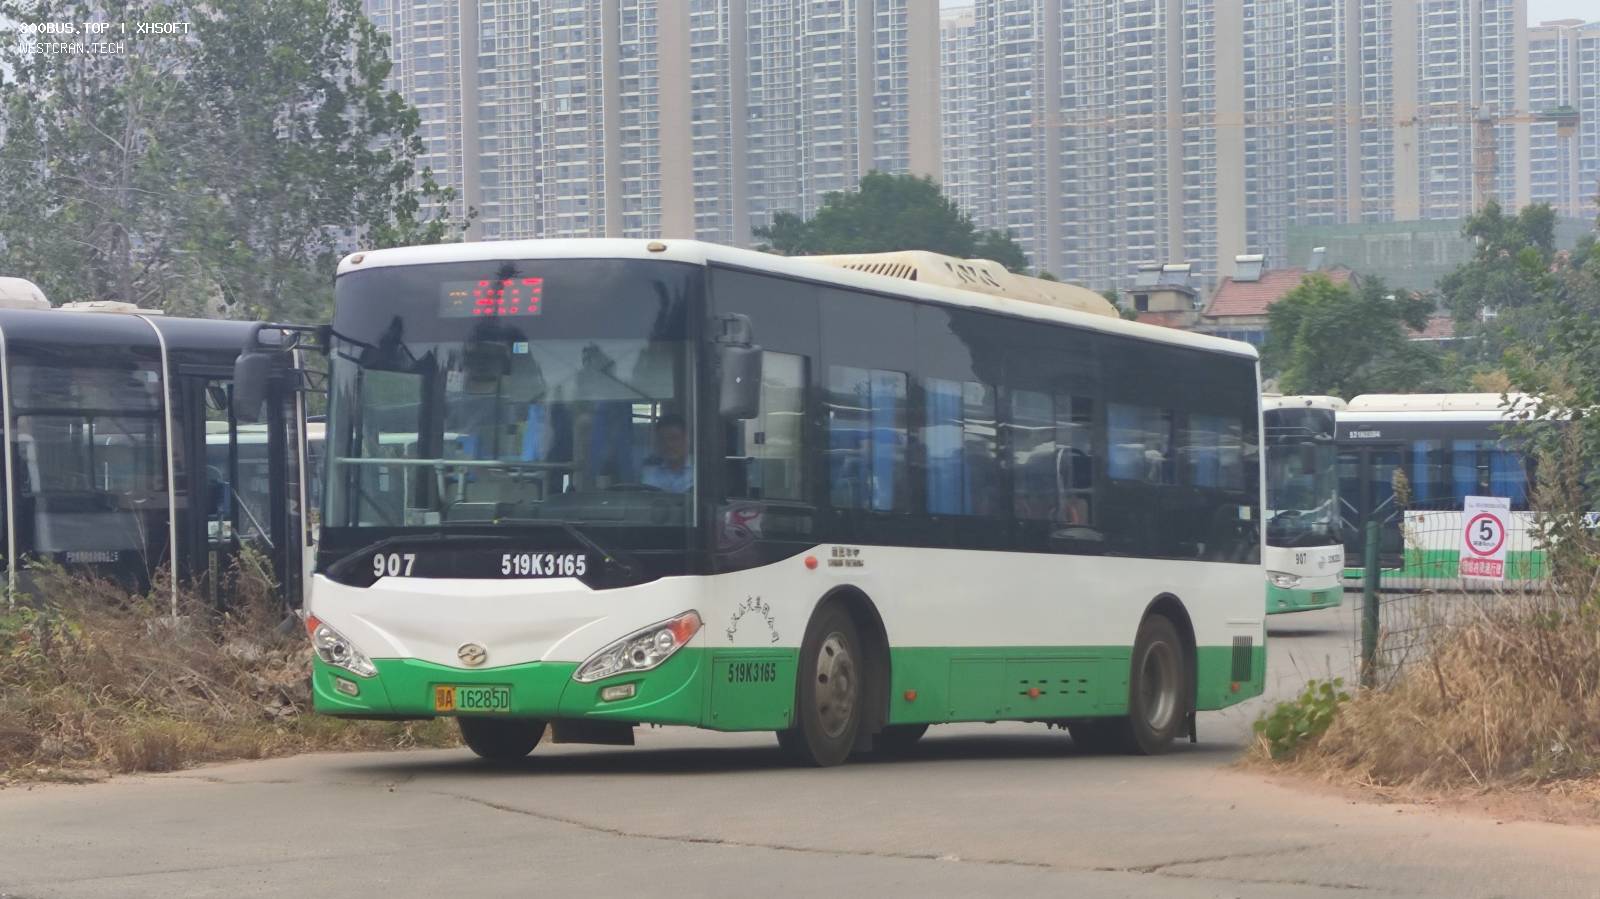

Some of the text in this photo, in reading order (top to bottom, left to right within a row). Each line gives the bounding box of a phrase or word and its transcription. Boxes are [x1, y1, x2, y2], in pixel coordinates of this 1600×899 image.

[1479, 519, 1493, 541] 5
[373, 553, 416, 577] 907
[501, 553, 586, 576] 519K3165
[1295, 552, 1307, 565] 907
[728, 662, 776, 683] 519K3165
